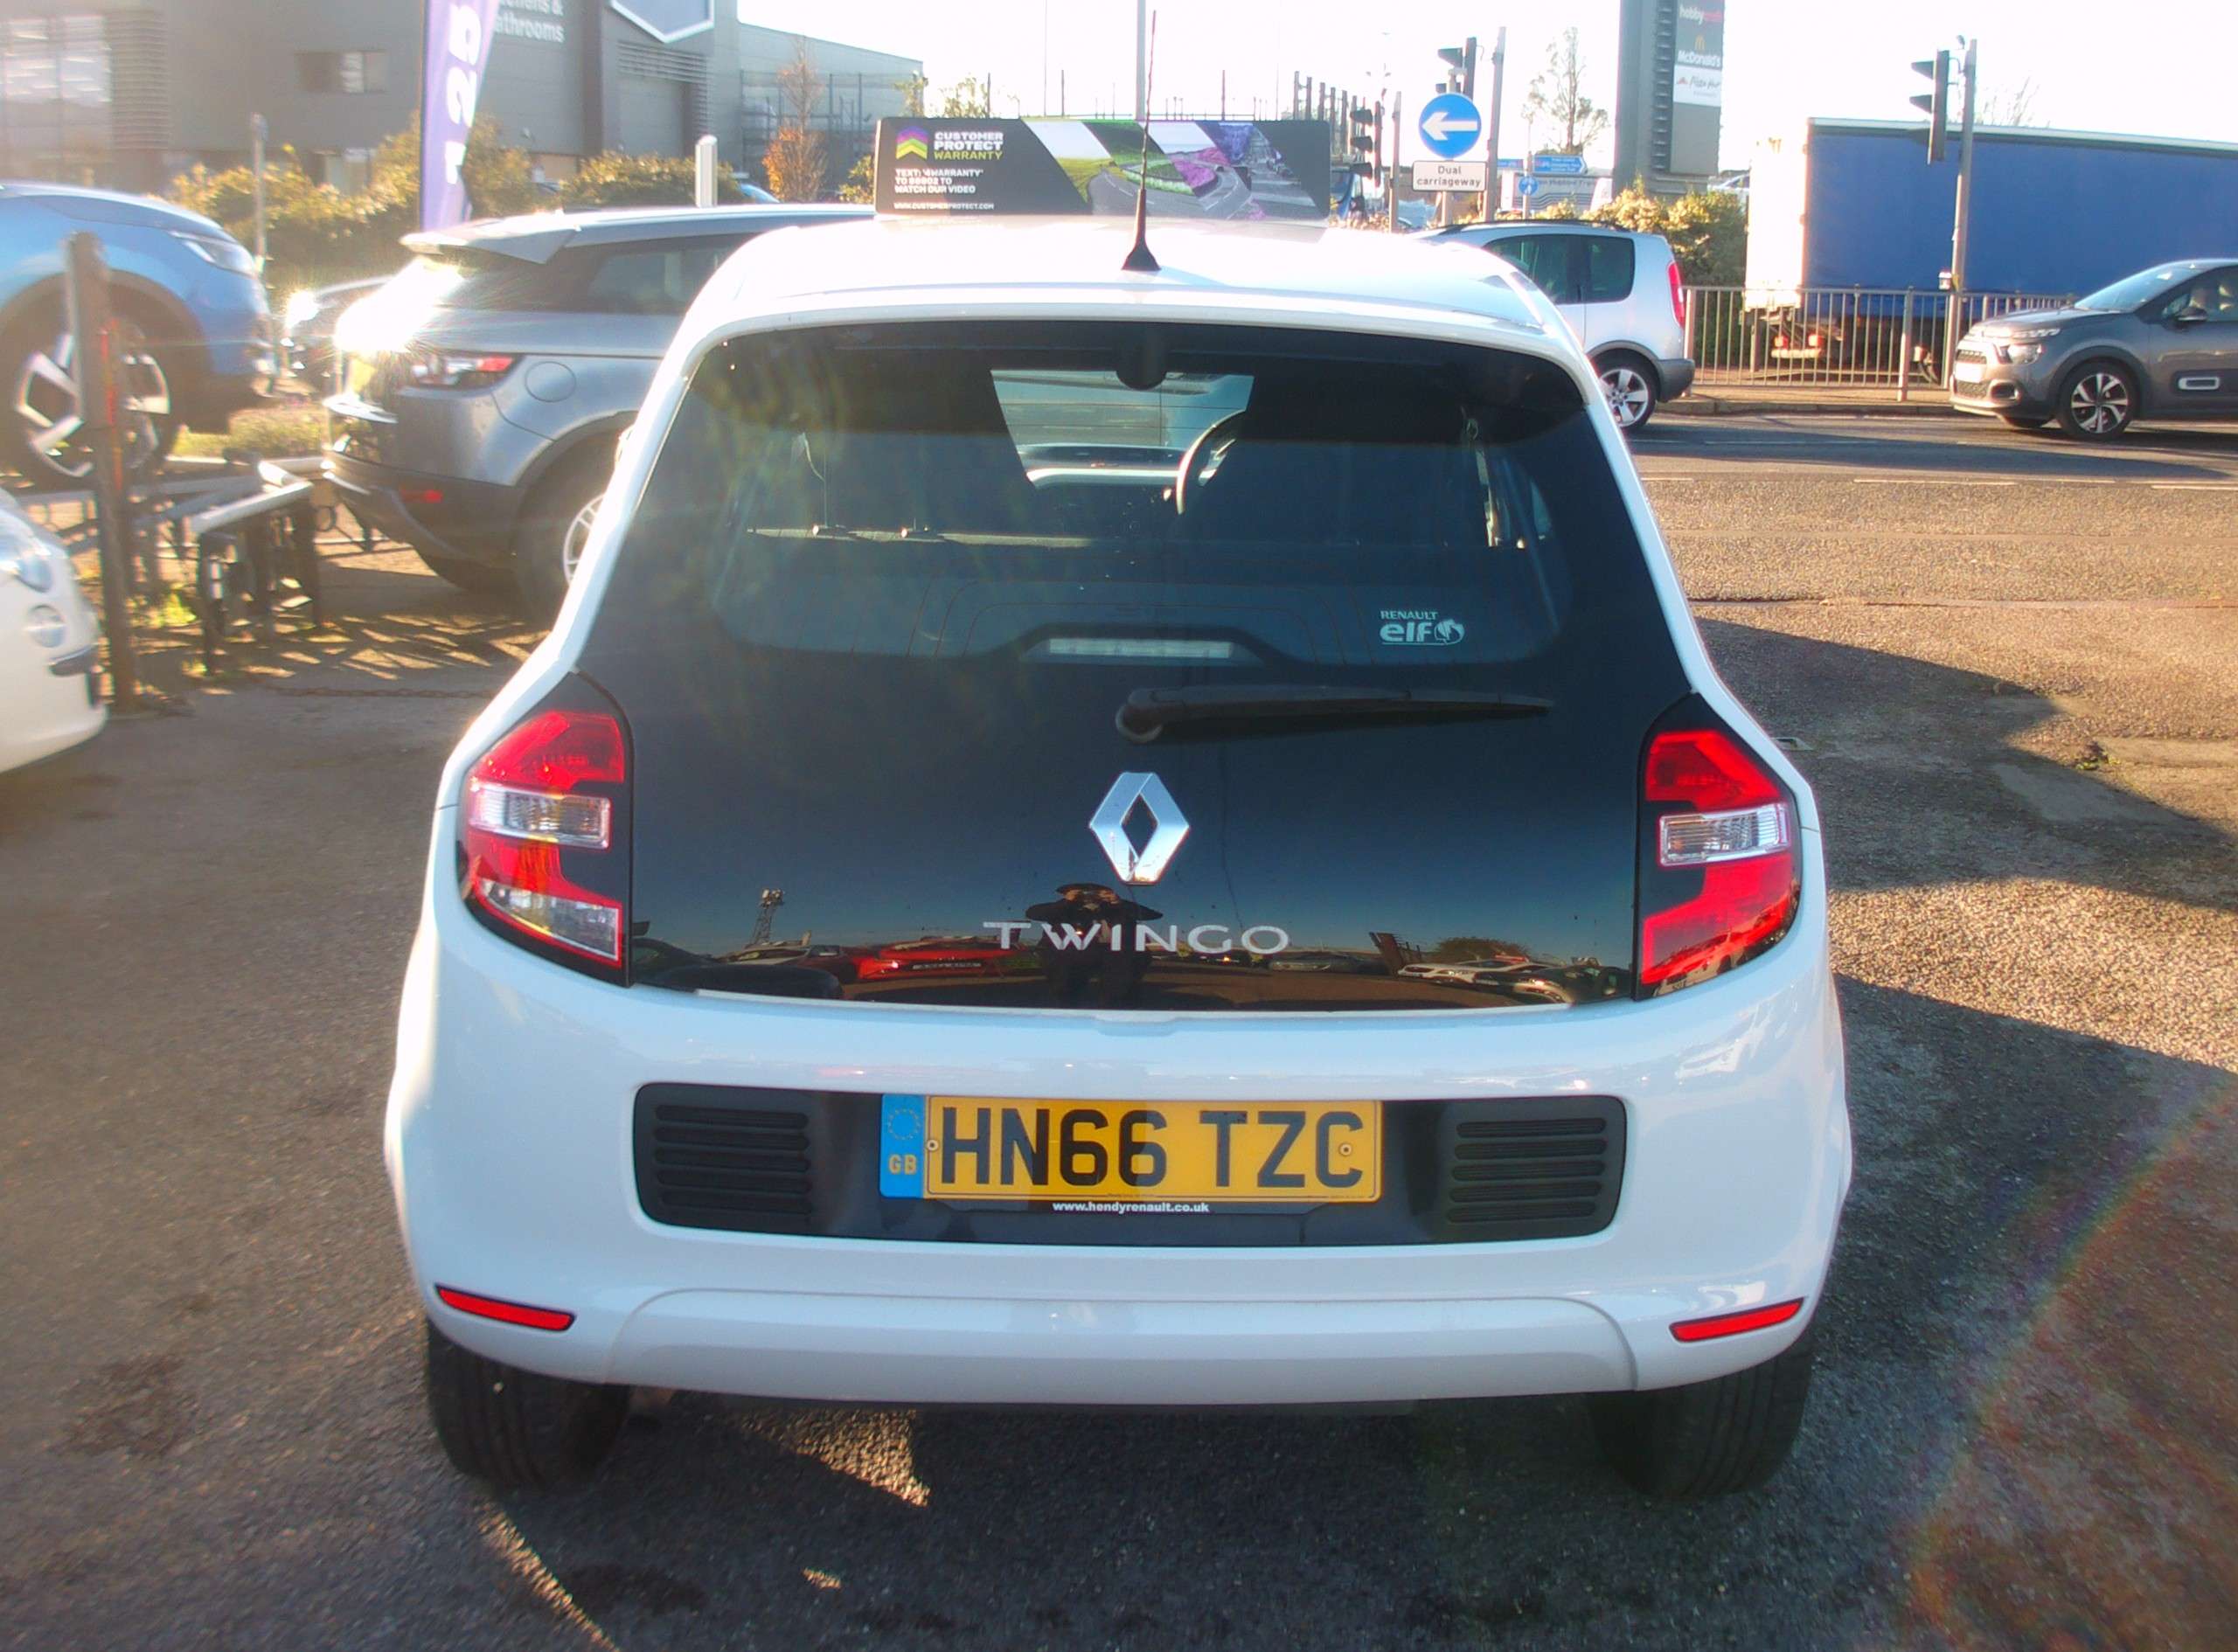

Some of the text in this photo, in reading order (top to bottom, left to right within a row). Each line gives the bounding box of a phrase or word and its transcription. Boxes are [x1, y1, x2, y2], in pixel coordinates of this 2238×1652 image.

[494, 11, 566, 43] athrooms
[934, 131, 1004, 140] CUSTOMER
[934, 141, 1004, 150] PROTECT
[934, 151, 1003, 160] WARRANTY
[1438, 165, 1462, 174] Dual
[1416, 177, 1481, 188] carriageway
[1380, 610, 1438, 620] RENAULT
[1380, 621, 1433, 642] elf
[983, 920, 1289, 954] TWINGO
[941, 1107, 1364, 1189] HN66 TZC
[888, 1154, 917, 1175] GB
[1052, 1201, 1210, 1214] www.hendyrenault.co.uk
